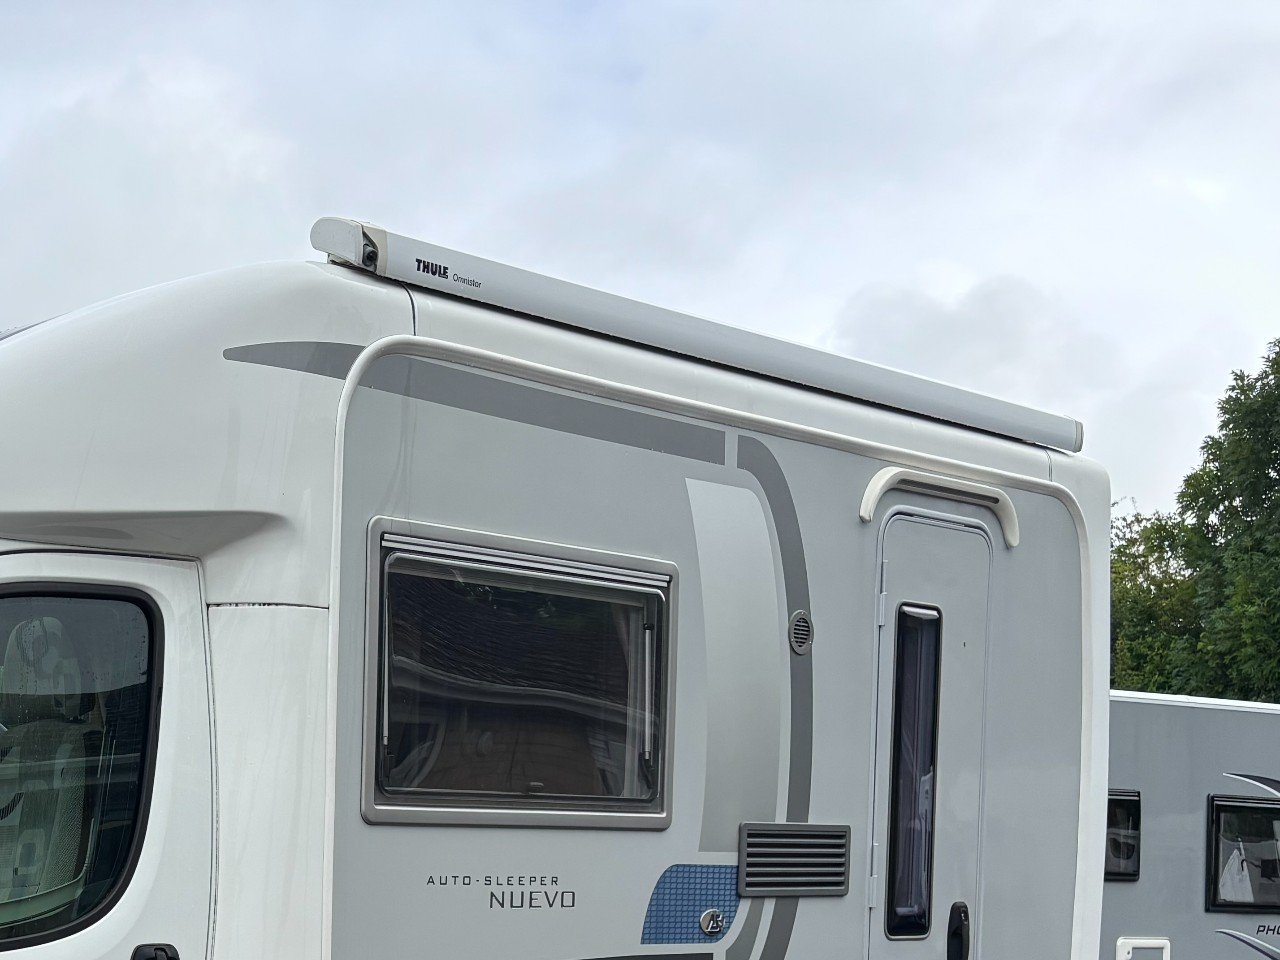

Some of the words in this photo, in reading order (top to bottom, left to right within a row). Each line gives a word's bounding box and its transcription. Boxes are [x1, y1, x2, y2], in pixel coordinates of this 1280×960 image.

[415, 258, 449, 280] THULE
[452, 273, 482, 289] Omnistor
[426, 875, 559, 886] AUTO-SLEEPER
[489, 891, 576, 909] NUEVO
